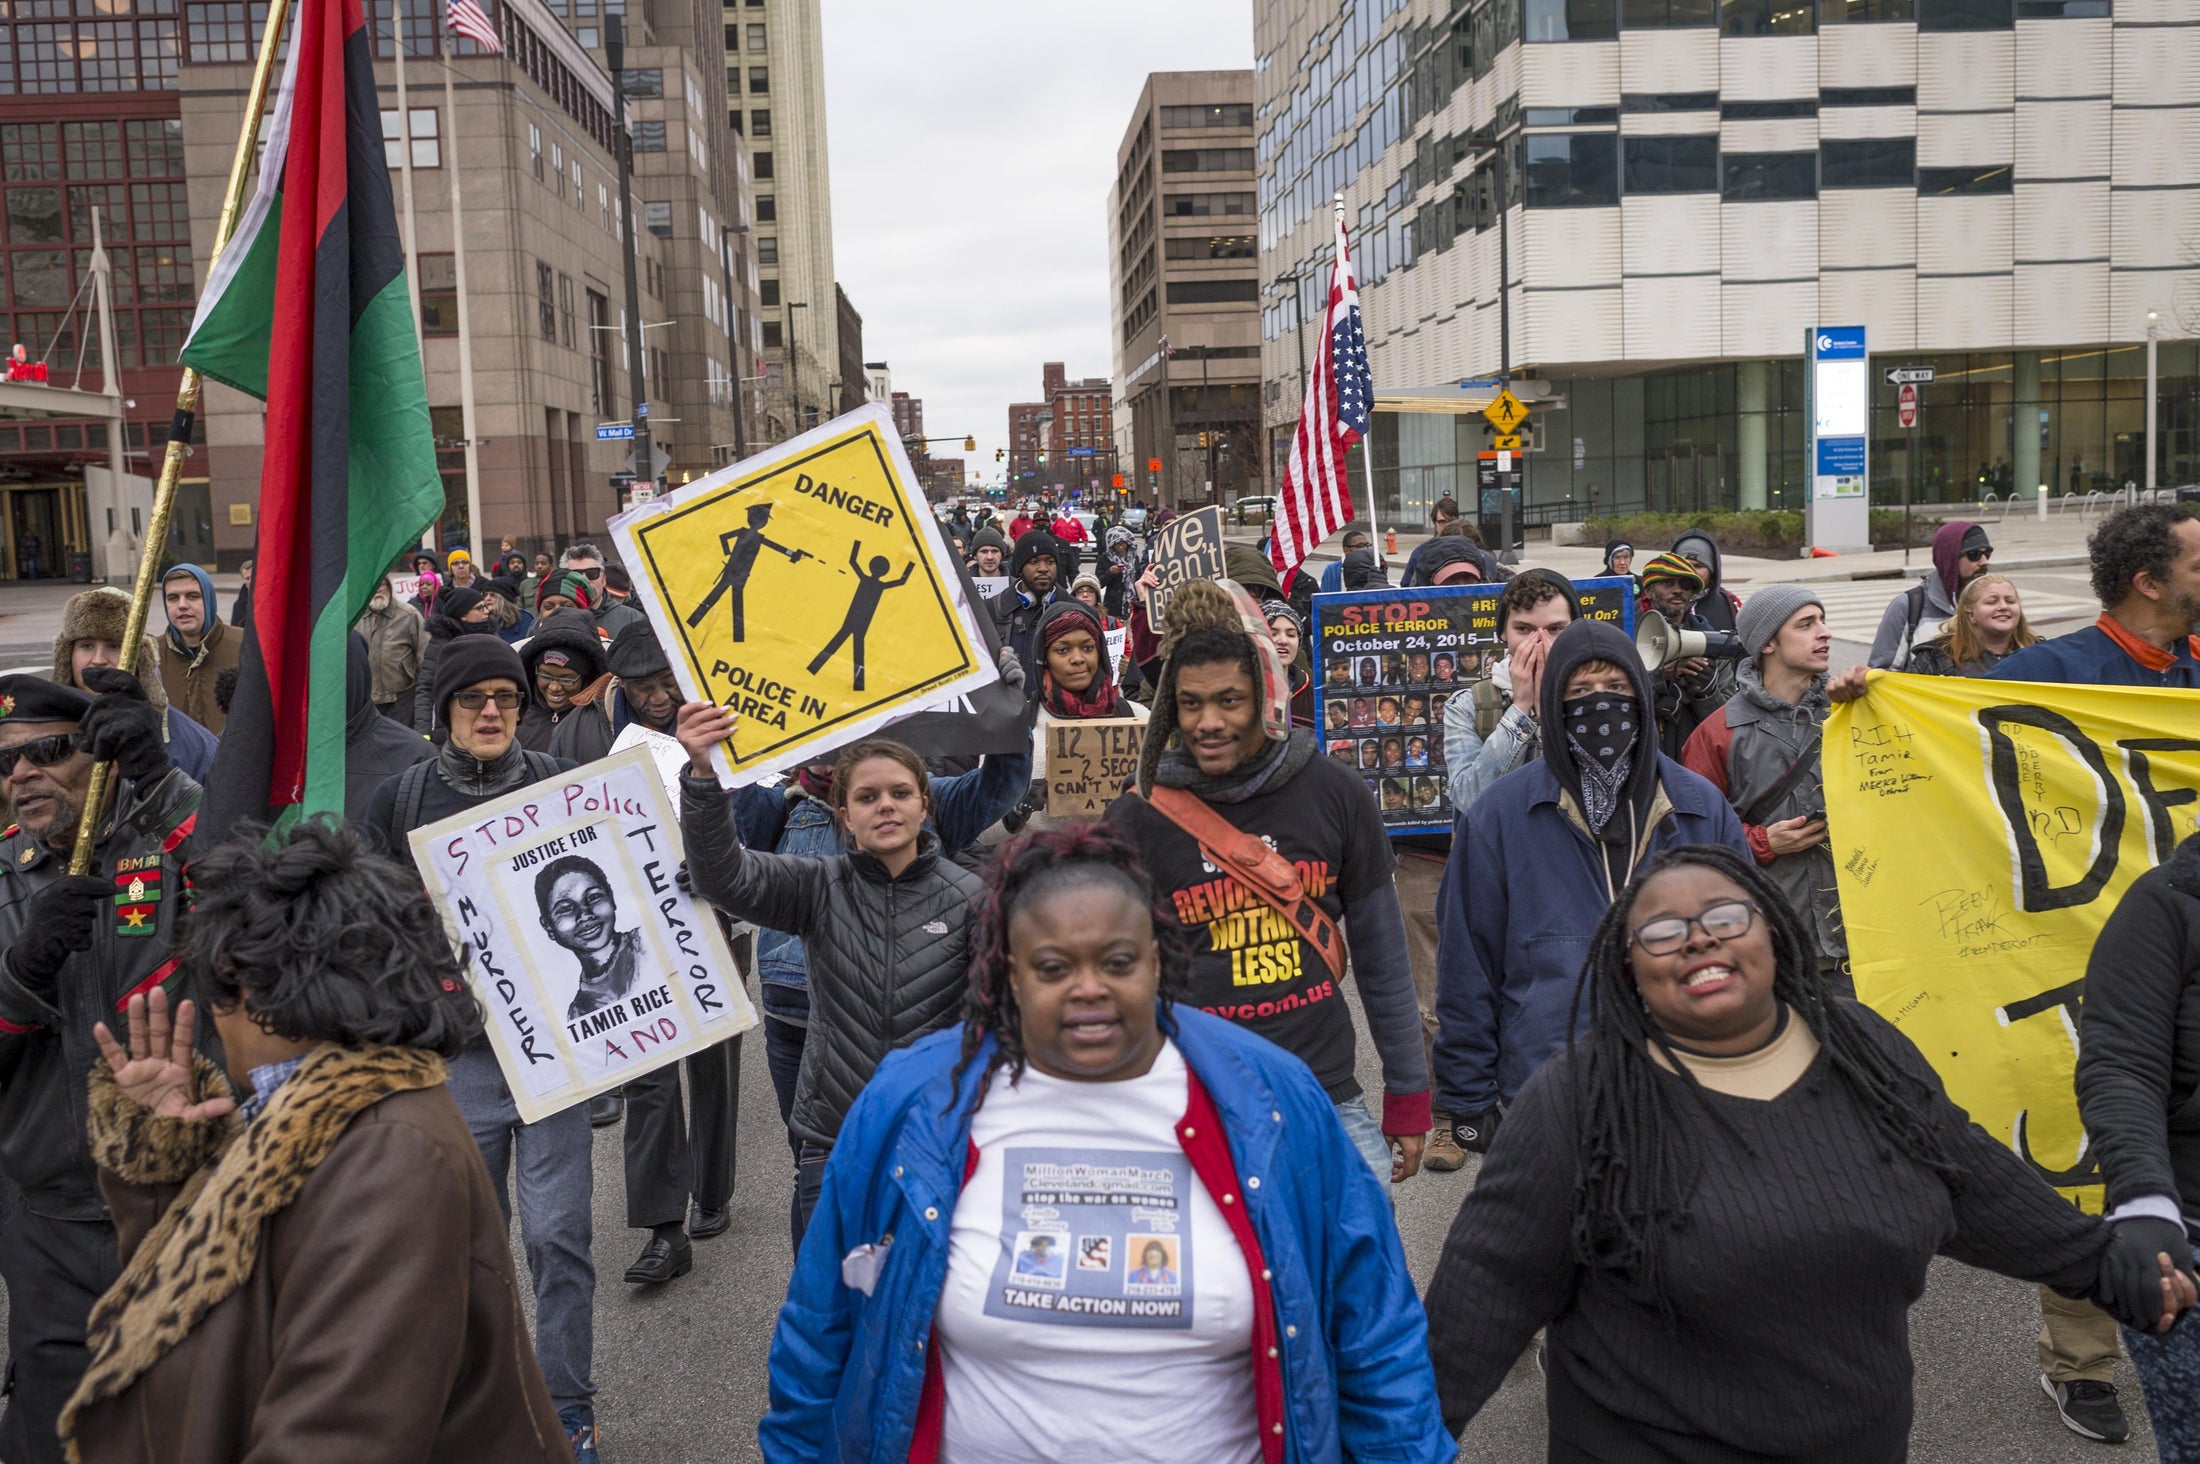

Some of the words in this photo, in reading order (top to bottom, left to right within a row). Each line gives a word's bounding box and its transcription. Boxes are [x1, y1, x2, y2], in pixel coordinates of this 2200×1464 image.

[1897, 371, 1910, 380] ONE
[1915, 371, 1929, 379] WAY
[624, 428, 633, 436] Dr
[794, 473, 894, 527] DANGER
[1324, 622, 1380, 637] POLICE
[1384, 618, 1448, 634] TERROR
[1343, 602, 1430, 625] STOP
[1594, 609, 1619, 620] On?
[1332, 639, 1400, 653] October
[1405, 635, 1431, 650] 24,
[711, 659, 796, 708] POLICE
[800, 694, 826, 720] IN
[724, 691, 787, 730] AREA
[1057, 726, 1086, 758] 12
[1054, 781, 1101, 794] CAN'T
[1085, 799, 1095, 809] A
[448, 804, 540, 876] STOP
[512, 836, 568, 872] JUSTICE
[570, 825, 598, 848] FOR
[624, 825, 723, 1013] TERROR
[1208, 906, 1301, 951] NOTHIN
[1231, 941, 1303, 986] LESS!
[458, 896, 555, 1065] MURDER
[567, 1004, 628, 1043] TAMIR
[630, 984, 673, 1018] RICE
[605, 1017, 678, 1067] AND
[1026, 1166, 1172, 1181] MillionWomanMarch
[1026, 1193, 1055, 1205] stop
[1059, 1192, 1080, 1204] the
[1083, 1194, 1107, 1204] war
[1111, 1195, 1128, 1204] on
[1130, 1195, 1175, 1207] women
[1004, 1288, 1053, 1309] TAKE
[1056, 1296, 1126, 1315] ACTION
[1130, 1300, 1181, 1317] NOW!
